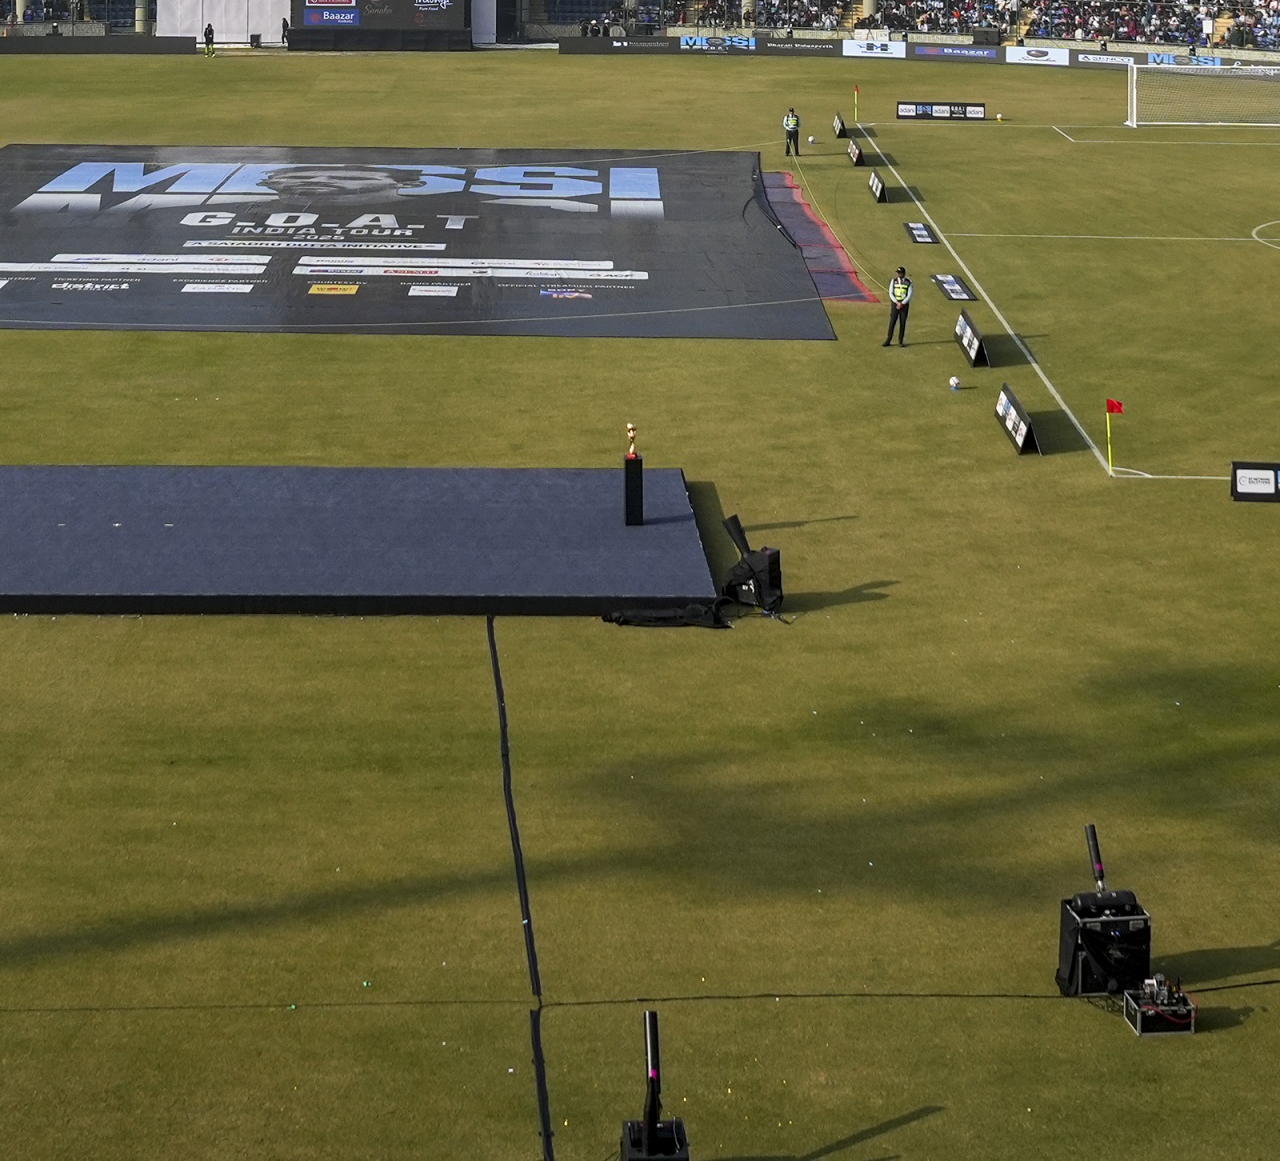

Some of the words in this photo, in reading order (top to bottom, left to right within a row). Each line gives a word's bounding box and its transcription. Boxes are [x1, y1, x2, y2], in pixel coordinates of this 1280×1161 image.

[323, 11, 354, 20] Baazar
[943, 48, 990, 56] Baazar
[231, 226, 316, 235] INDIA
[334, 227, 413, 236] TOUR
[51, 282, 130, 290] district
